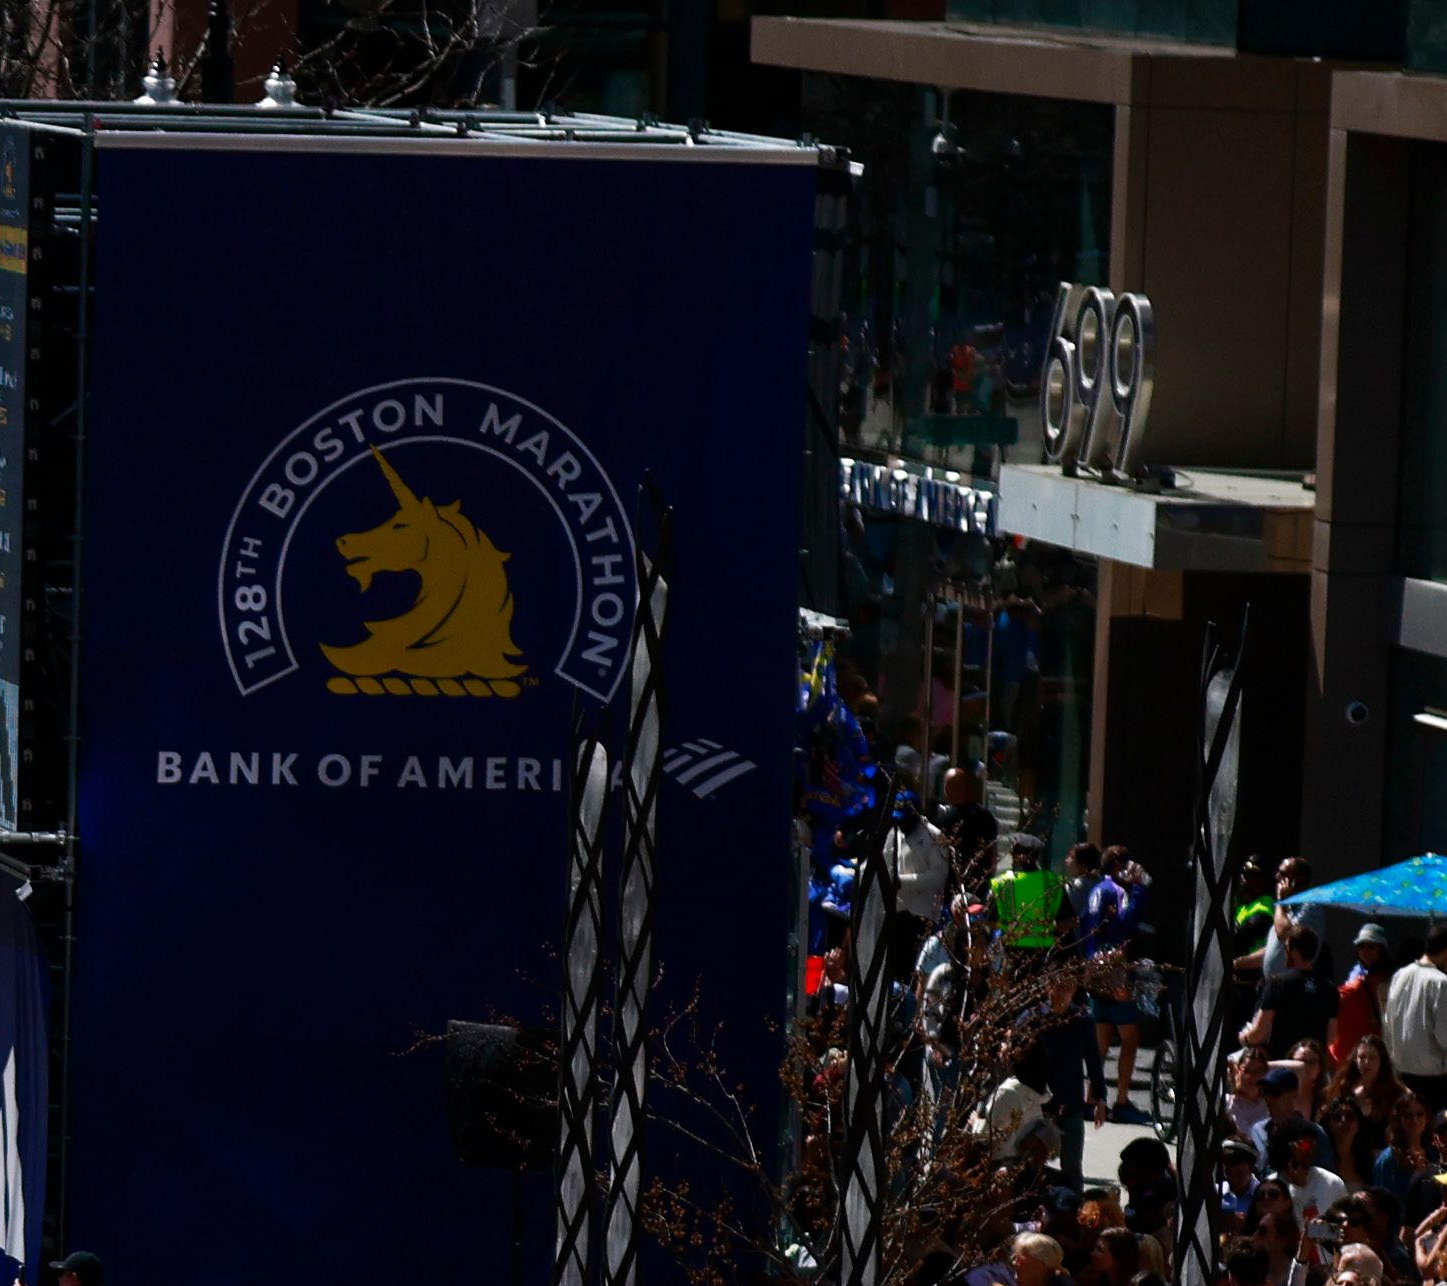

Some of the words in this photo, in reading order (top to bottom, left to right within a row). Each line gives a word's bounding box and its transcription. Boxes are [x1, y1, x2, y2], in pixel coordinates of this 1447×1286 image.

[1042, 280, 1153, 482] 699
[233, 536, 278, 668] 128TH
[259, 390, 443, 519] BOSTON
[479, 401, 626, 664] MARATHON
[156, 748, 300, 789] BANK
[316, 750, 384, 790] OF
